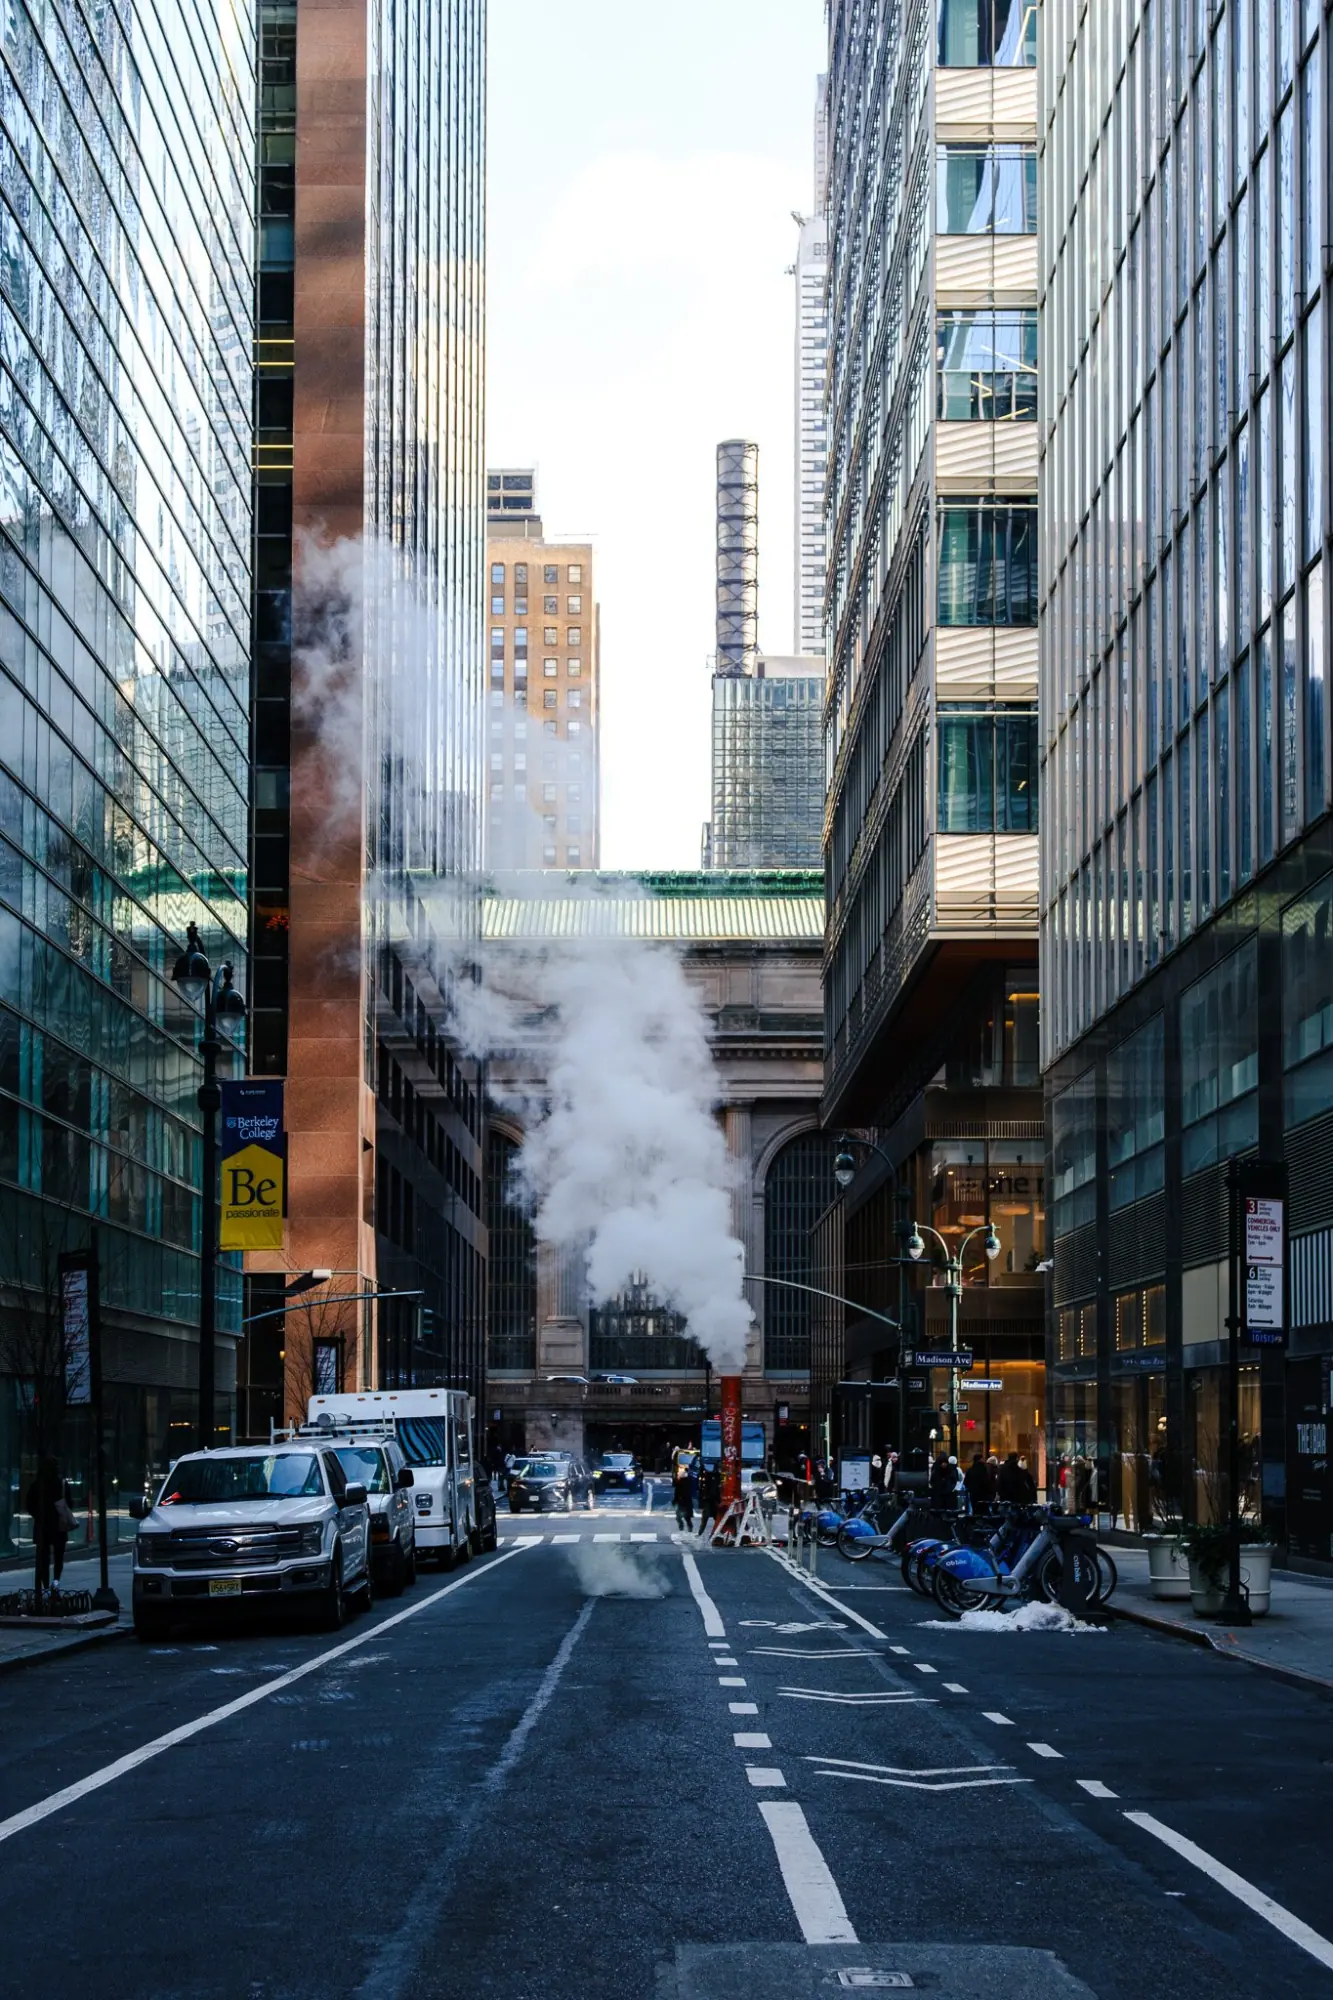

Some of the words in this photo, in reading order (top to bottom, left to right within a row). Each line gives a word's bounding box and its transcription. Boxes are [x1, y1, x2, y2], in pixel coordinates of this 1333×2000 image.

[237, 1116, 279, 1129] Berkeley
[240, 1127, 276, 1140] College
[227, 1168, 276, 1206] Be
[1248, 1200, 1256, 1213] 3
[226, 1208, 280, 1220] passionate
[1248, 1217, 1276, 1226] COMMERCIAL
[1269, 1225, 1281, 1233] ONLY
[1249, 1266, 1256, 1280] 6
[917, 1355, 952, 1365] Madison
[954, 1356, 970, 1365] Ave
[963, 1381, 988, 1389] Madison
